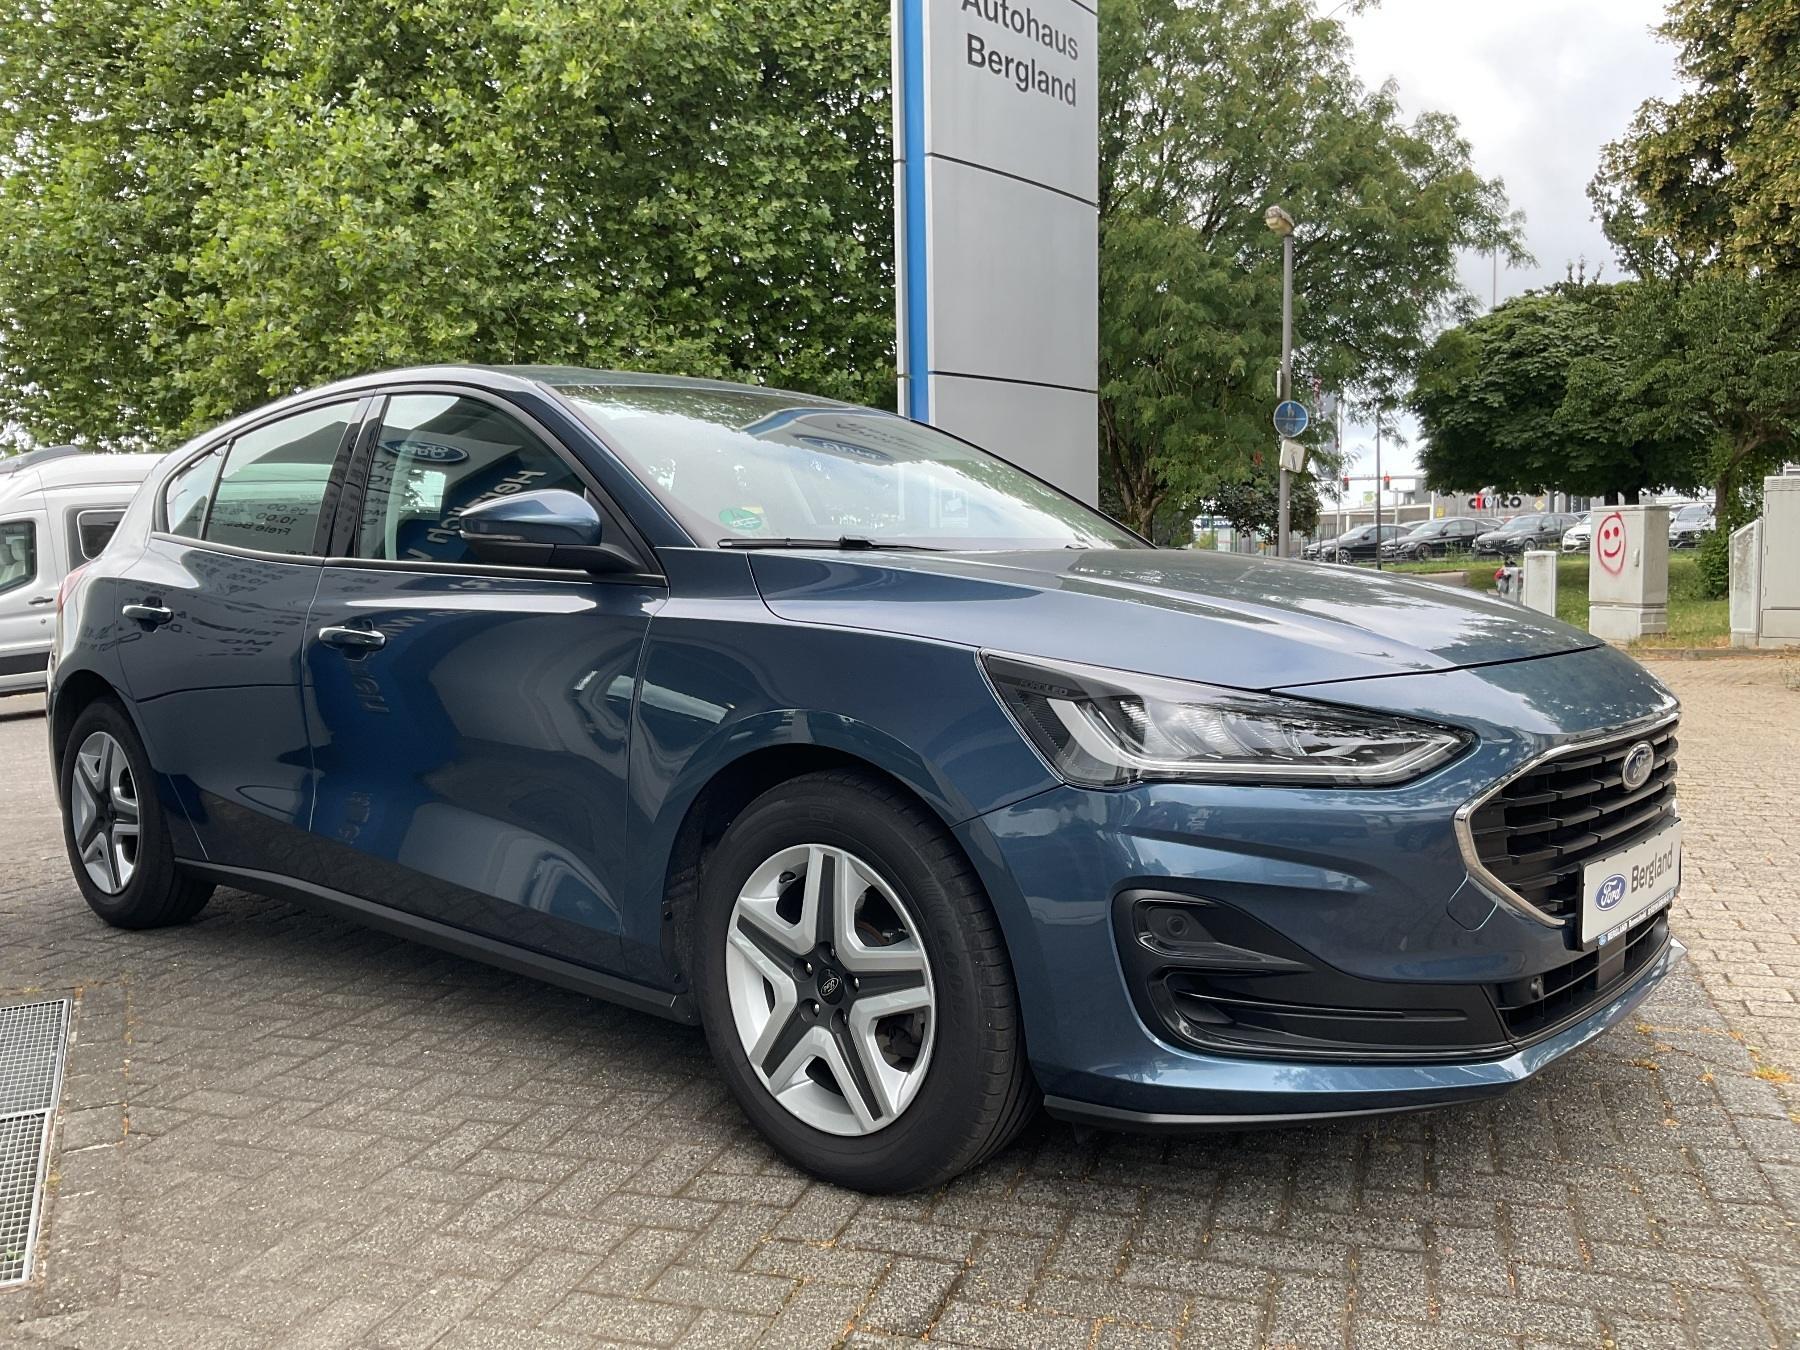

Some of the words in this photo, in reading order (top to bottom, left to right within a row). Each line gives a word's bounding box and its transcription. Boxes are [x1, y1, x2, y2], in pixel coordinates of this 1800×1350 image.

[967, 32, 1076, 107] Bergland
[1601, 880, 1622, 906] Ford
[1631, 841, 1673, 894] Bergland
